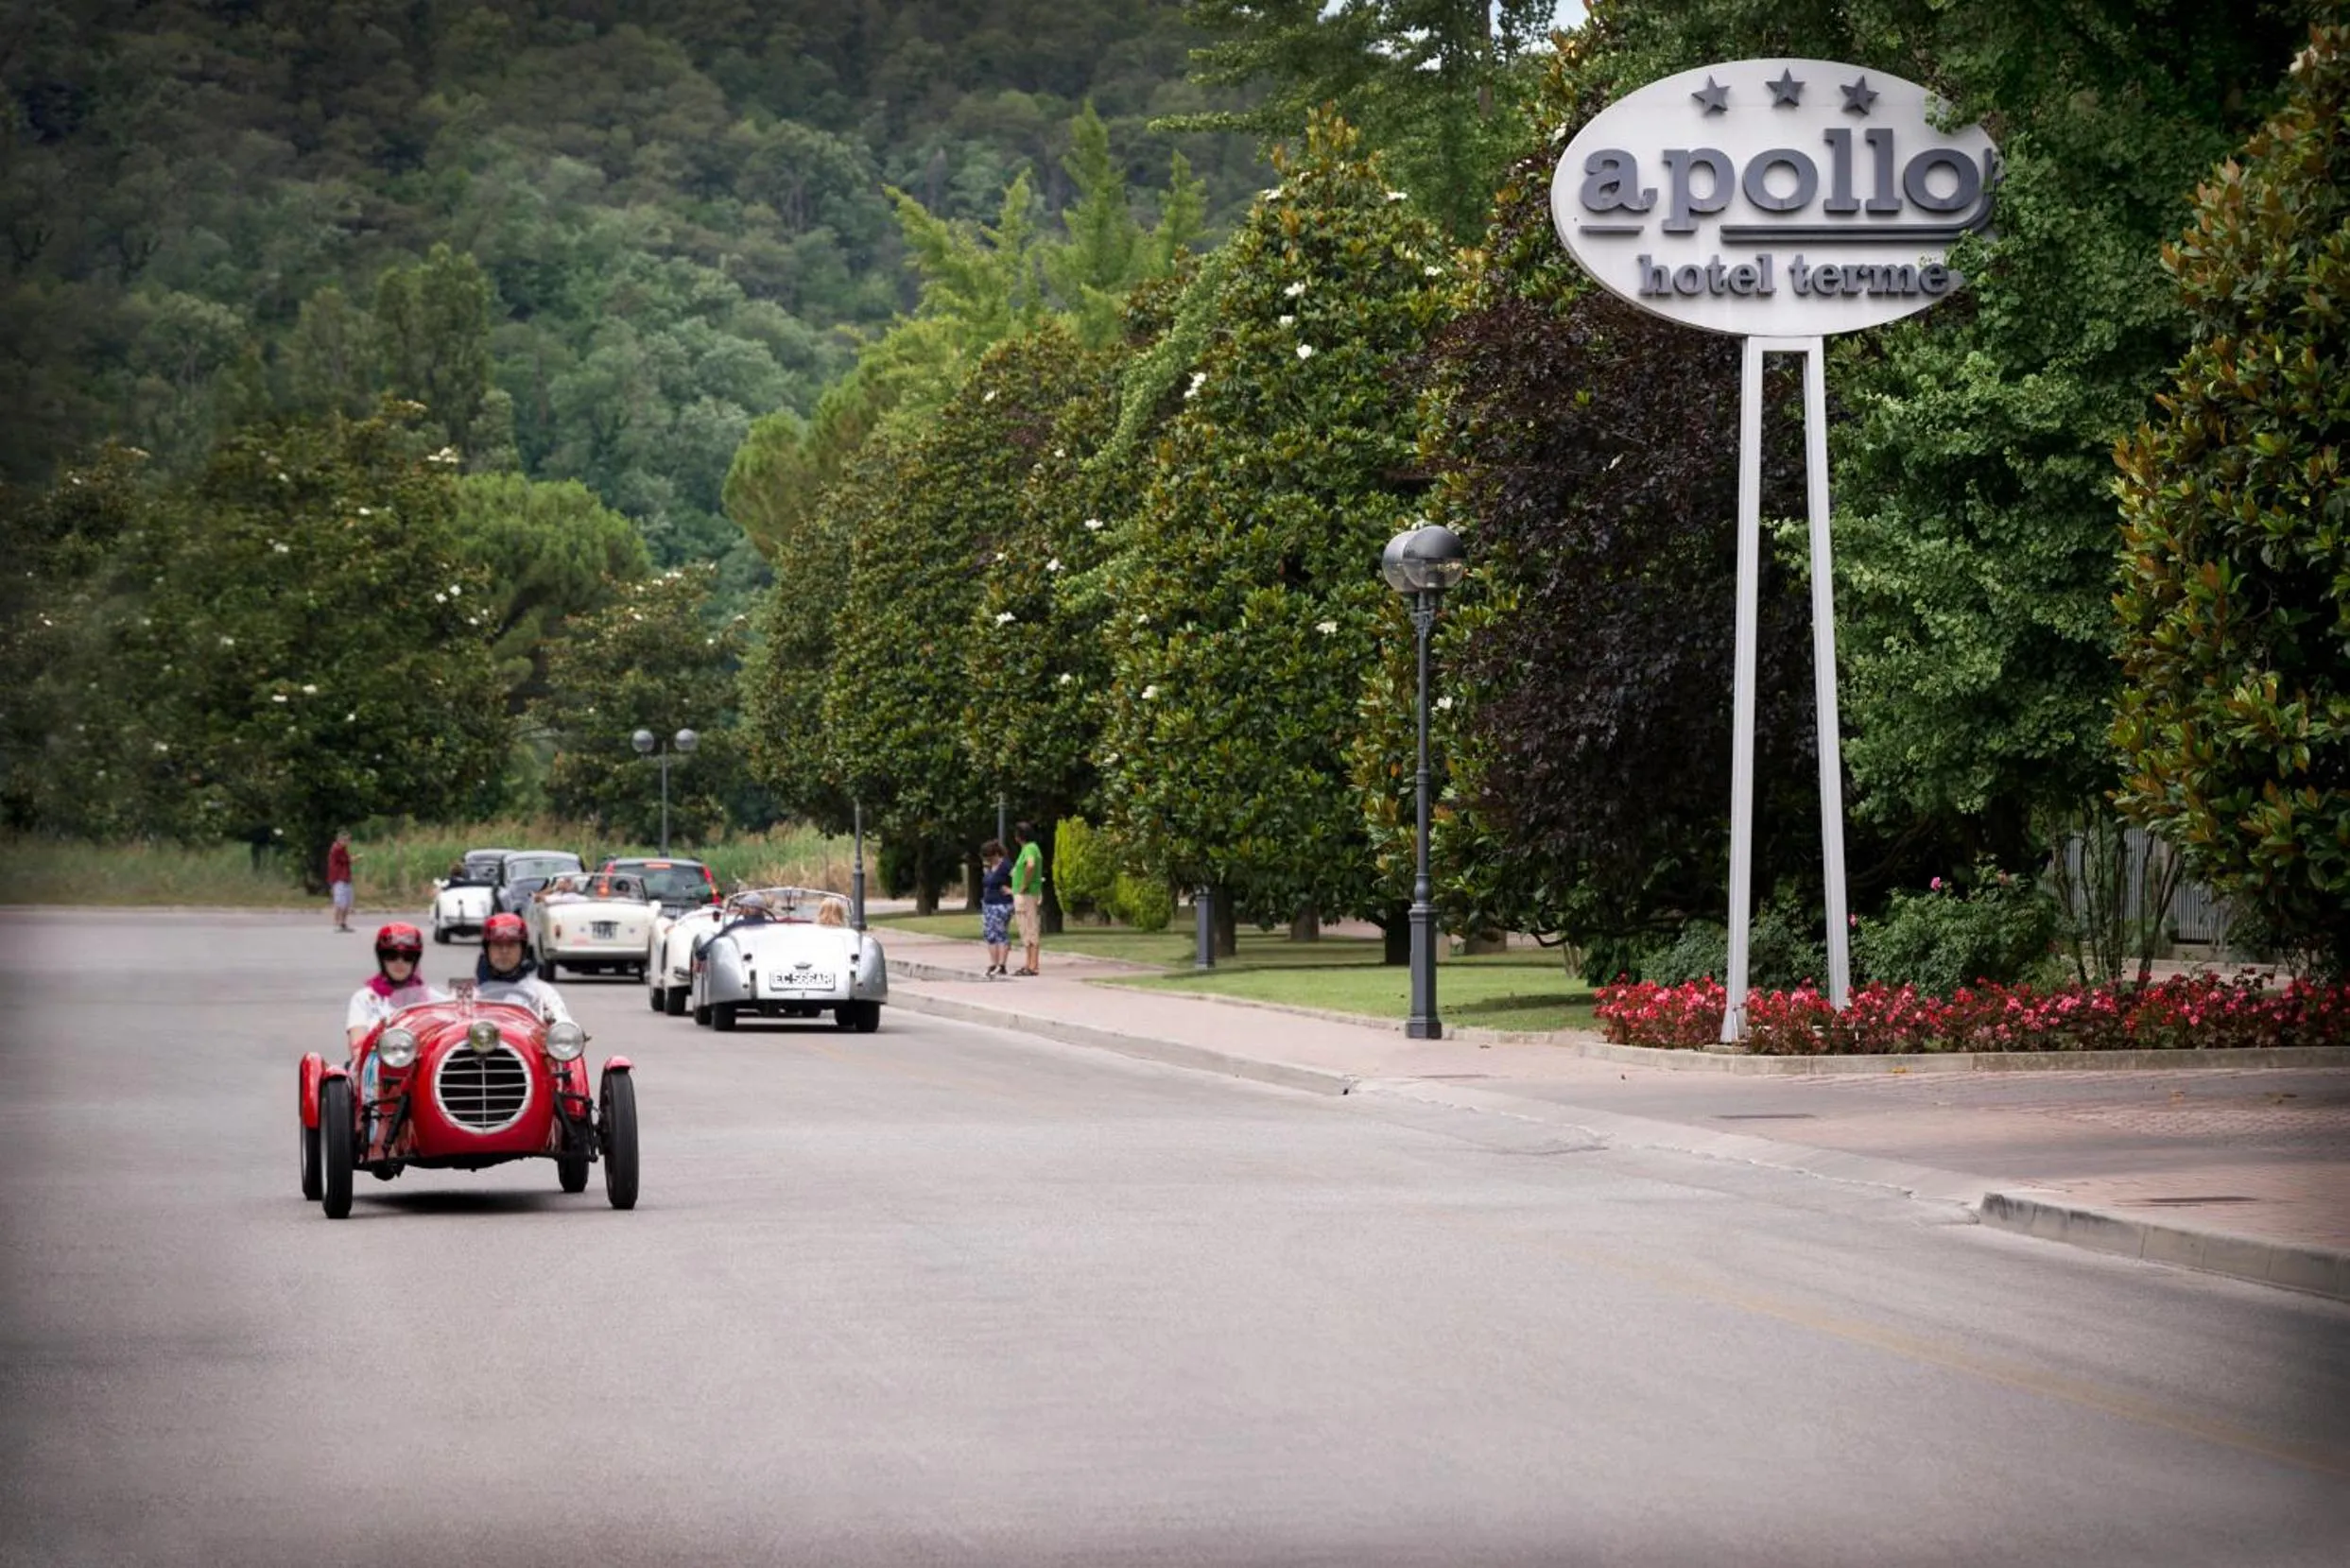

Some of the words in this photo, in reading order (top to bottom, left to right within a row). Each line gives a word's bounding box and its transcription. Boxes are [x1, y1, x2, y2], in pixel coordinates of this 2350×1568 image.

[1580, 129, 1980, 233] apollo
[1637, 254, 1776, 298] hotel
[1788, 254, 1950, 297] terme
